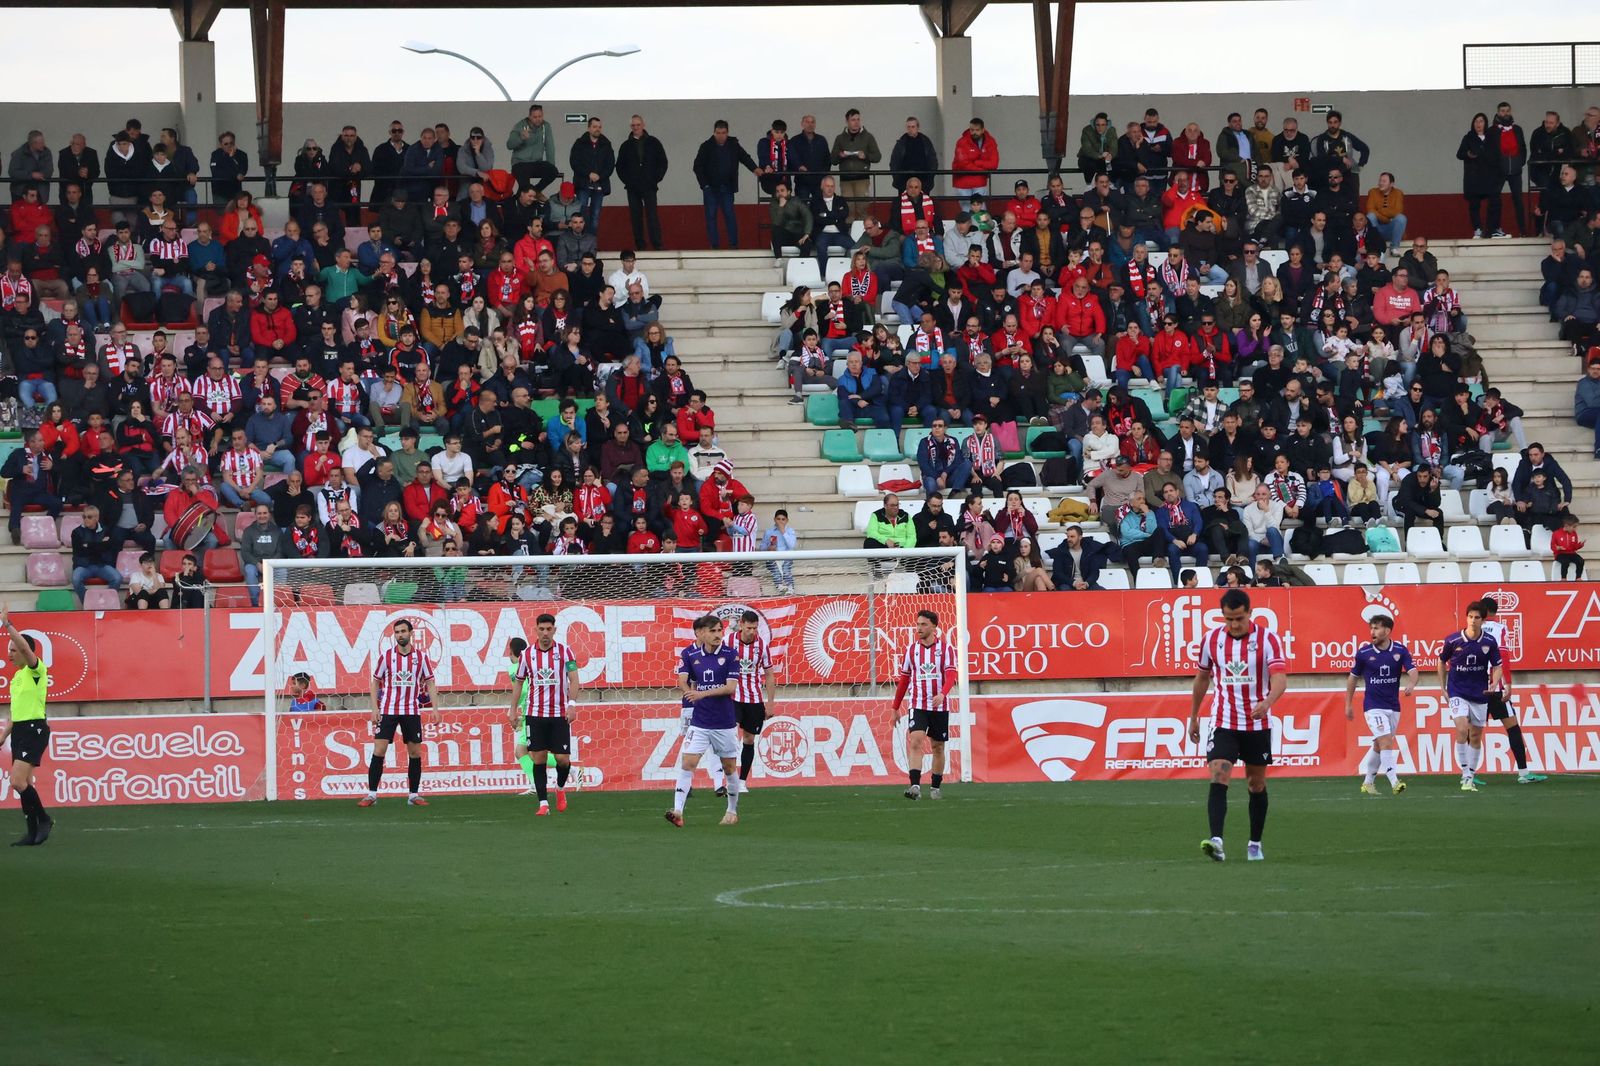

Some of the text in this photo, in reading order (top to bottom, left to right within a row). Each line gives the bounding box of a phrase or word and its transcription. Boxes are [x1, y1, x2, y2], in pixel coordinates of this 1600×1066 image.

[716, 607, 746, 618] FOND
[1172, 595, 1278, 640] fiso
[1546, 590, 1600, 638] ZA
[828, 615, 1110, 652] CENTO ÓPTICO
[1544, 648, 1600, 663] AYUNT
[1105, 714, 1321, 758] FRIY
[1374, 715, 1383, 726] 11
[49, 725, 244, 761] Escuela
[325, 723, 592, 771] Sumilr
[642, 715, 888, 781] ZORA
[1358, 730, 1600, 775] ZAMRANA
[1105, 756, 1209, 770] REFRIGERACION
[54, 764, 246, 803] infantil
